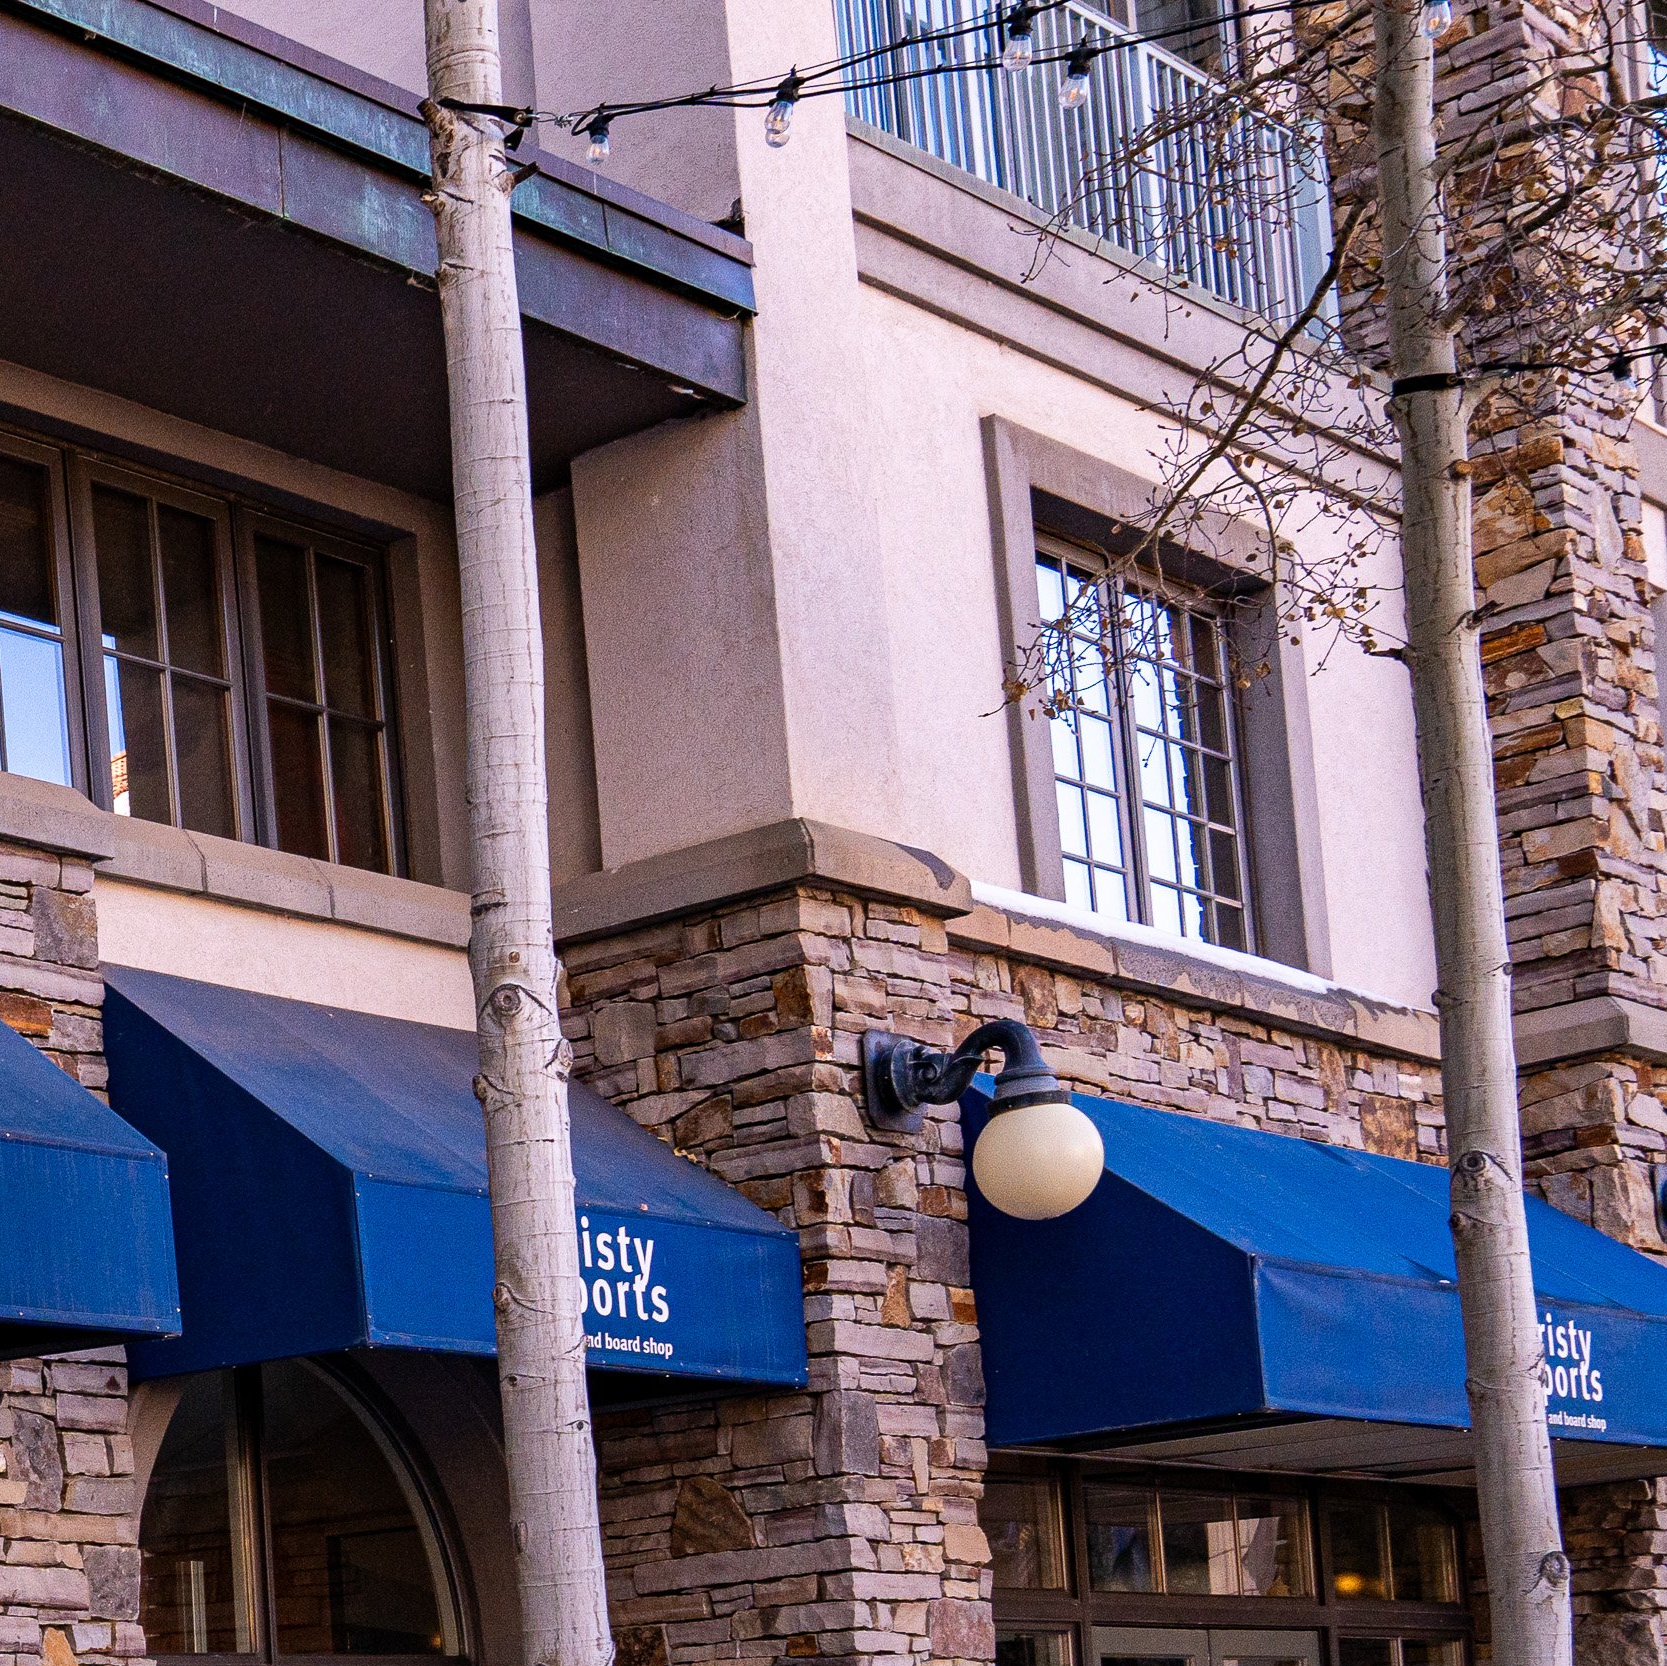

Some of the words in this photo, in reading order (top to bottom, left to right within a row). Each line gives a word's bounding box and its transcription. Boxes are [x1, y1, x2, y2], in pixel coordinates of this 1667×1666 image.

[580, 1215, 654, 1289] isty
[579, 1273, 670, 1323] orts
[587, 1332, 602, 1348] nd
[604, 1332, 640, 1352] board
[643, 1337, 673, 1359] shop
[1537, 1313, 1591, 1372] risty
[1544, 1361, 1603, 1406] ports
[1548, 1411, 1563, 1425] and
[1563, 1411, 1586, 1427] board
[1587, 1414, 1607, 1433] shop
